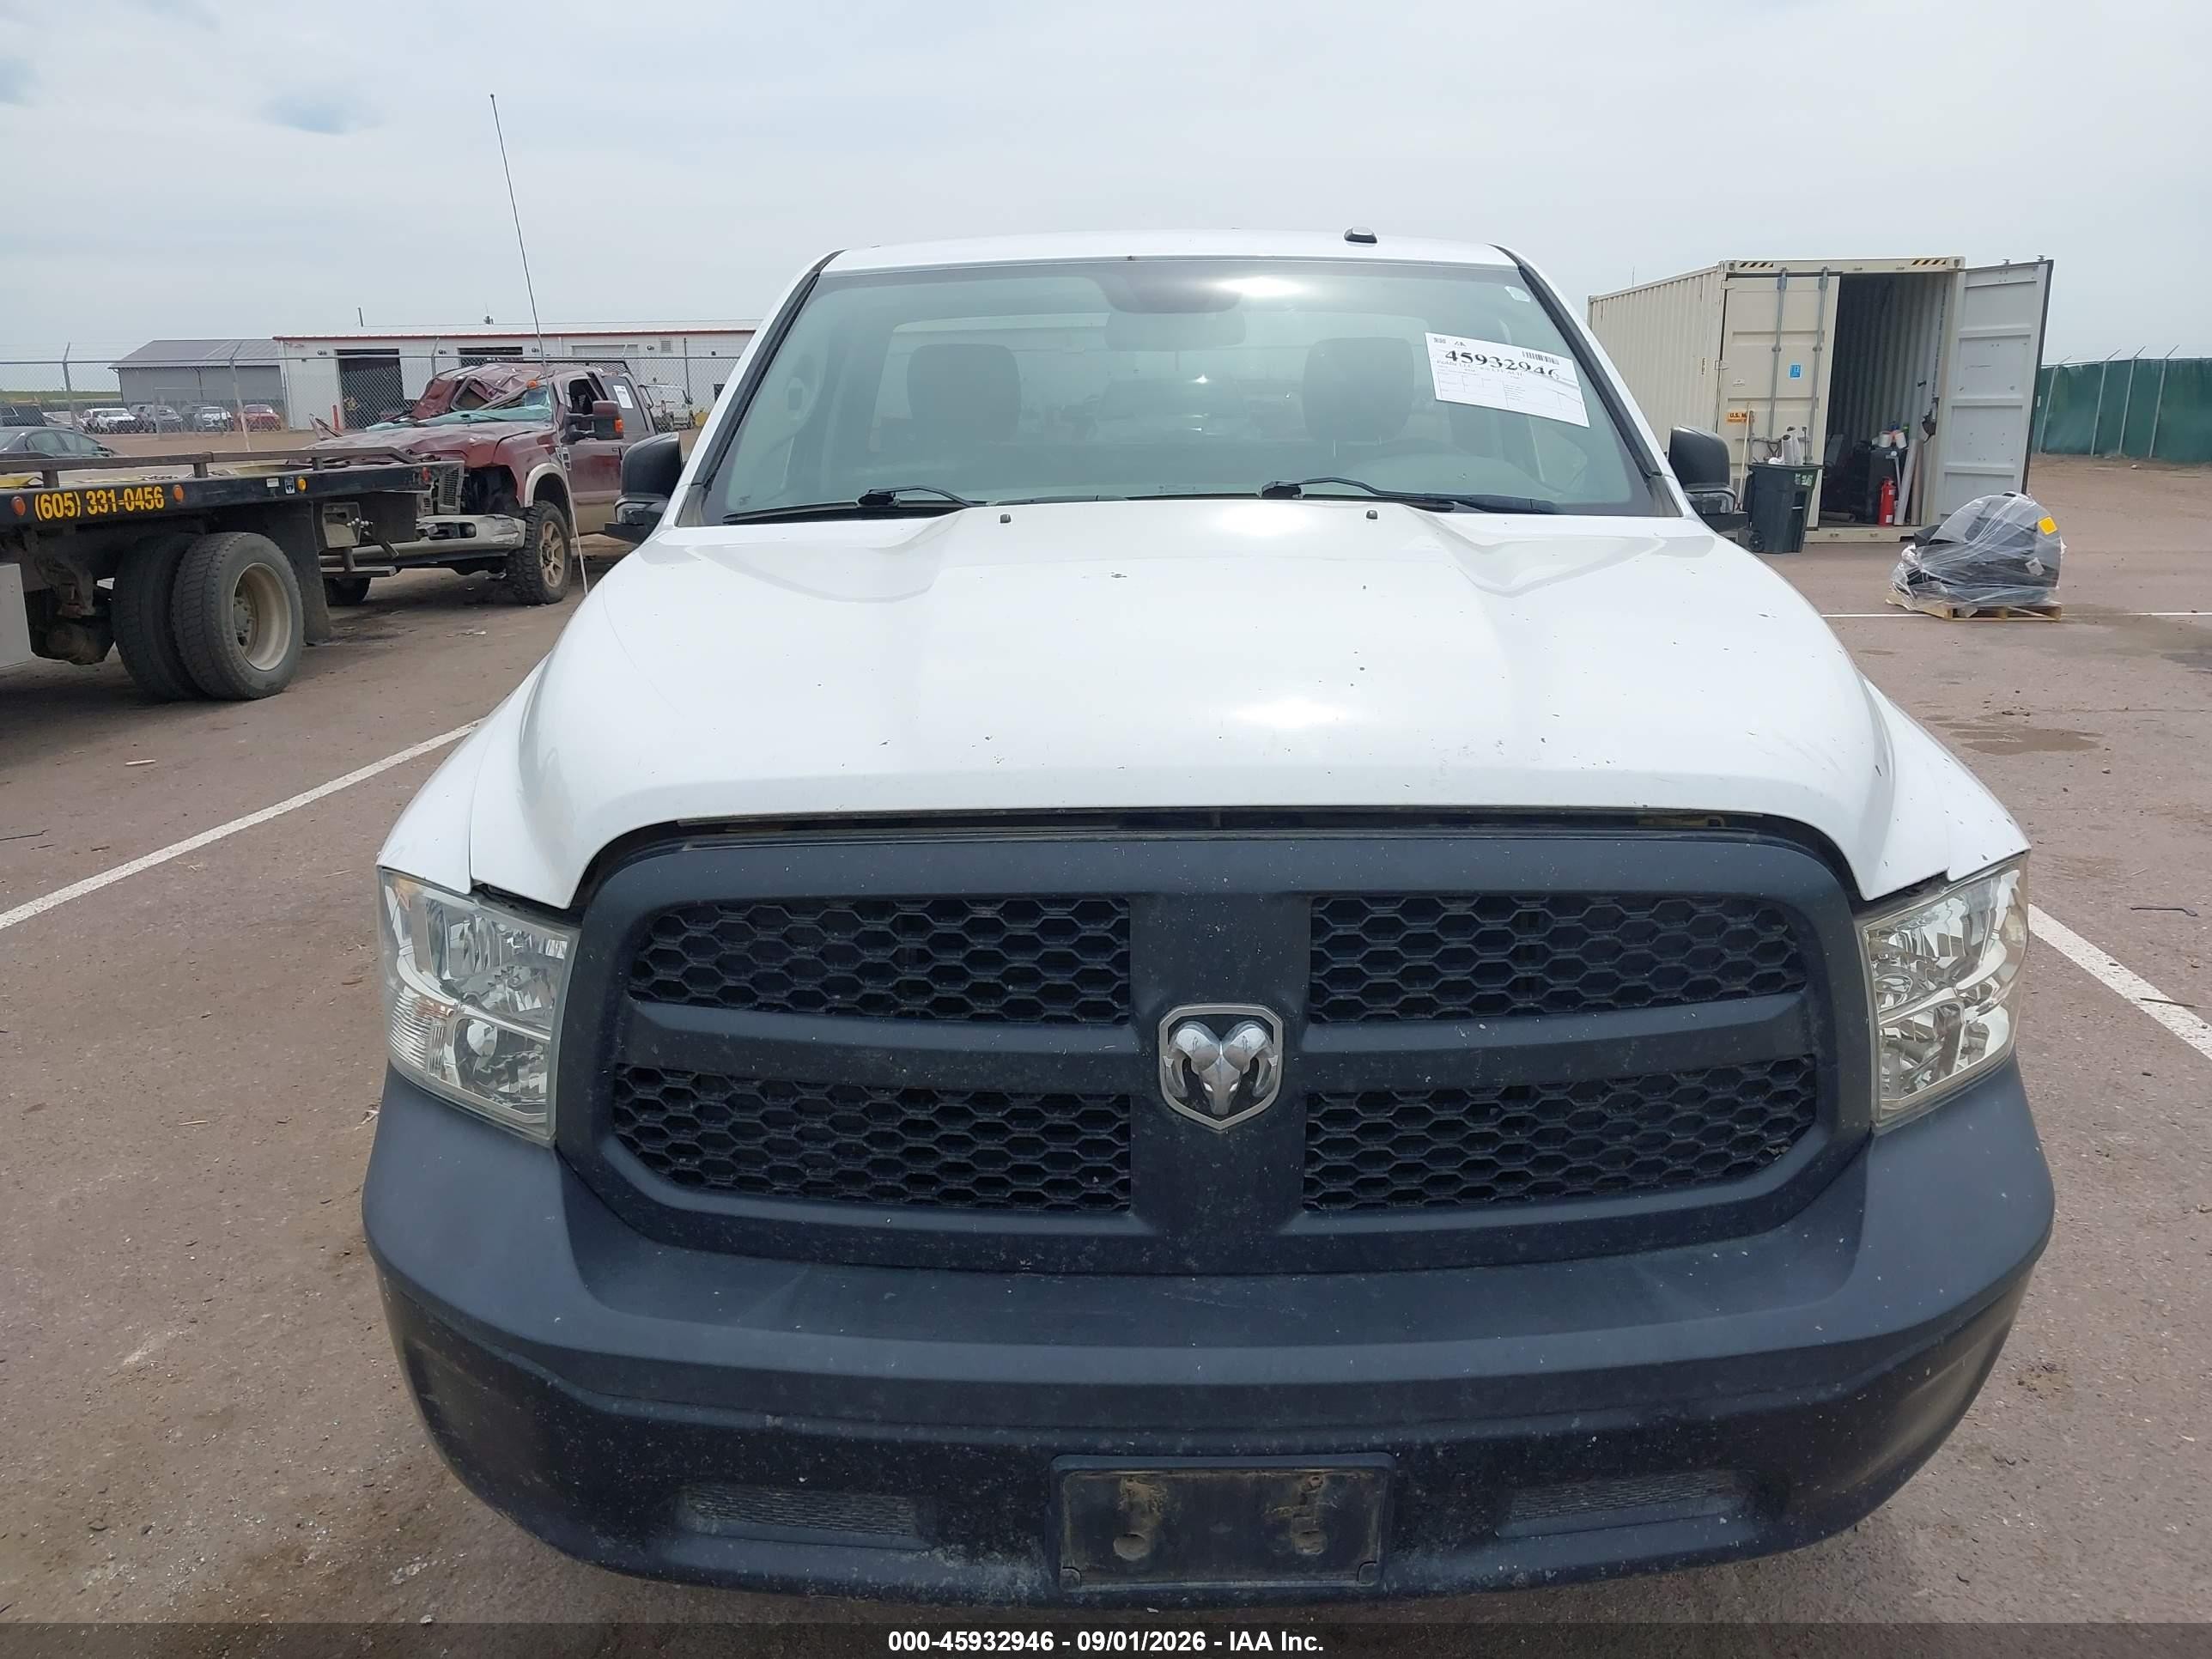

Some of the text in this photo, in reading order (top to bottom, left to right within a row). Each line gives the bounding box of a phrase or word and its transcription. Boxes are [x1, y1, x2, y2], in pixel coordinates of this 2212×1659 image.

[1444, 349, 1560, 380] 45932946
[34, 485, 165, 521] (605) 331-0456
